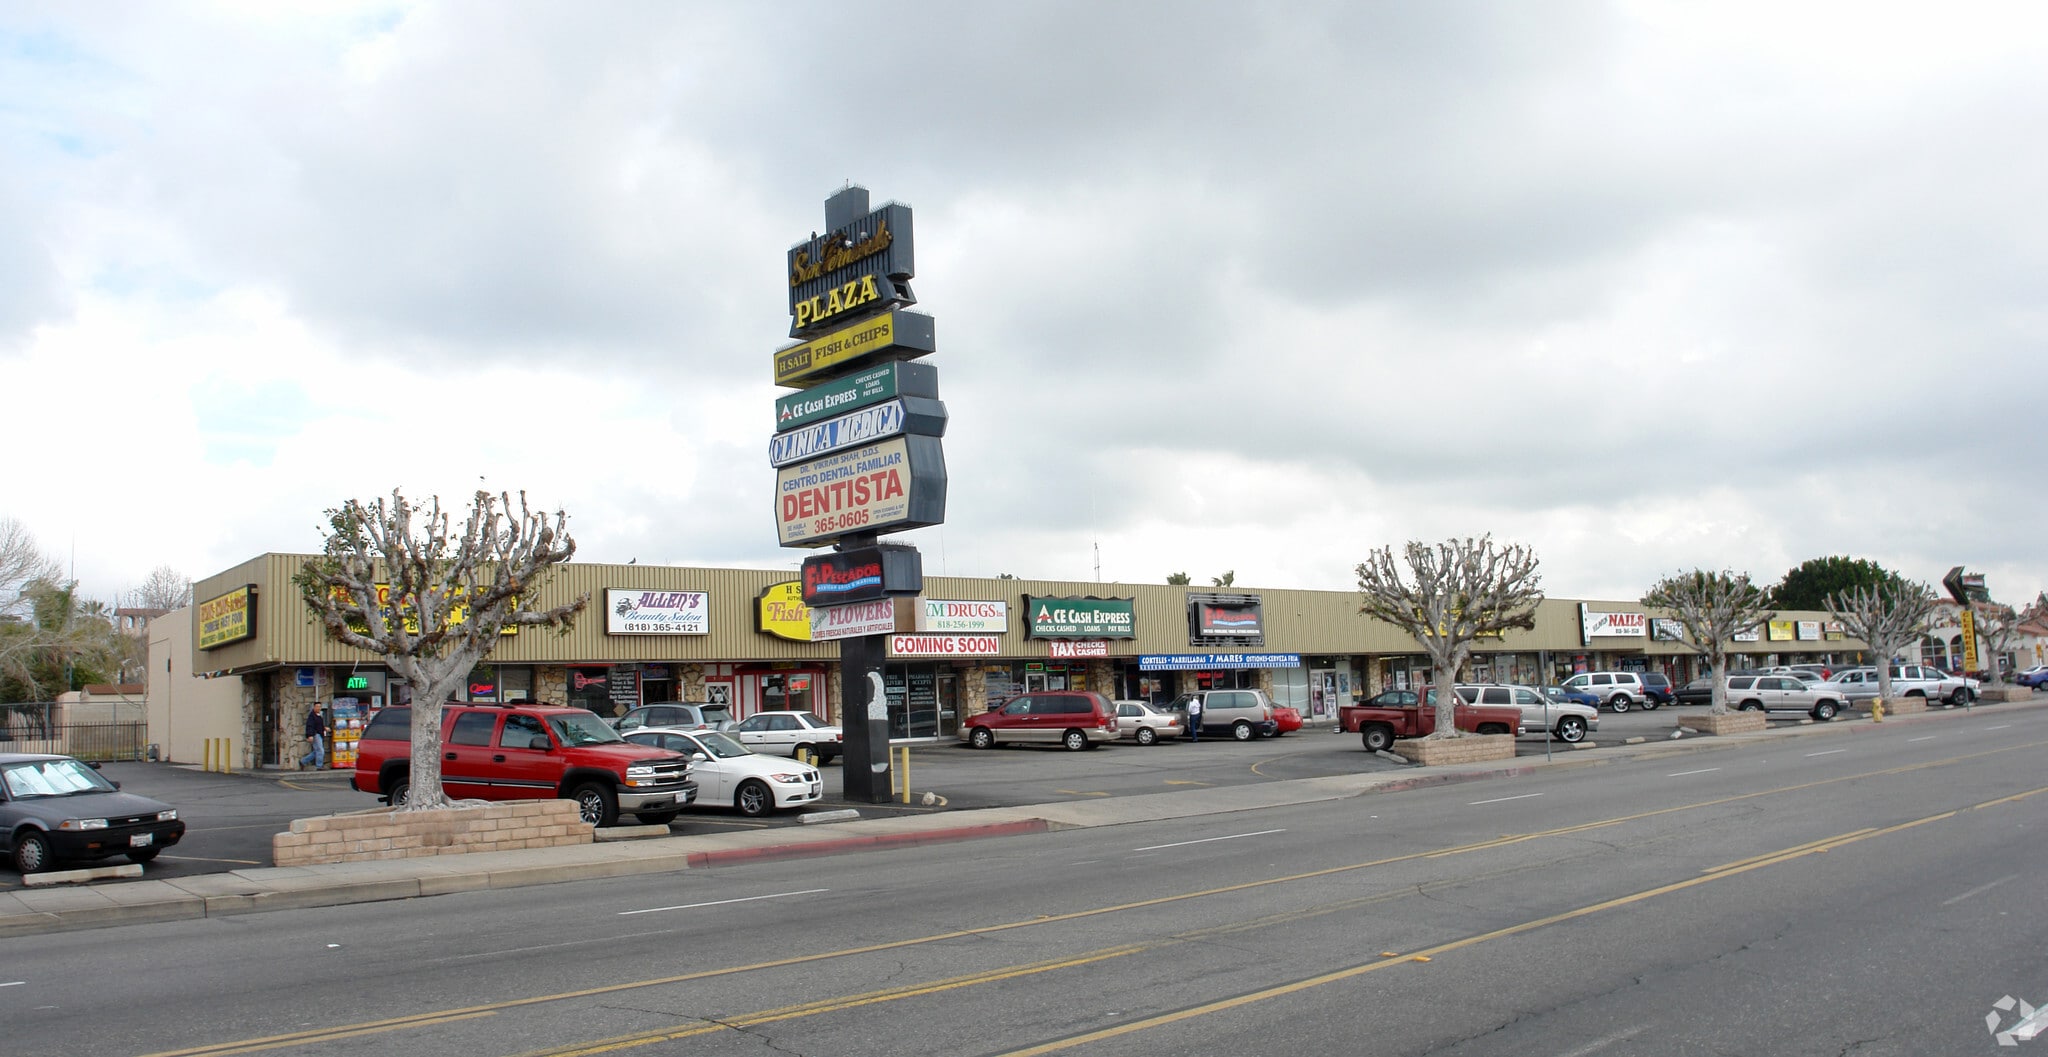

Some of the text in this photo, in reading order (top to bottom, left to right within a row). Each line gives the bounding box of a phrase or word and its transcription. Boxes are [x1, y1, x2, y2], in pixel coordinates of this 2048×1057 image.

[795, 274, 879, 328] PLAZA
[815, 341, 842, 360] FISH
[844, 339, 852, 349] &
[852, 323, 890, 347] CHIPS
[855, 368, 890, 385] CHECKS CASHED
[865, 380, 880, 389] LOANS
[804, 401, 823, 415] CASH
[825, 389, 857, 408] EXPRESS
[774, 403, 902, 463] CLINICA MEDICA
[783, 452, 902, 492] CENTRO DENTAL FAMILIAR
[813, 457, 839, 471] VIKRAM
[783, 468, 904, 522] DENTISTA
[814, 508, 869, 534] 365-0605
[820, 563, 881, 584] PESCADOR
[624, 611, 702, 622] Beauty Salon
[767, 601, 805, 622] Fish
[829, 600, 893, 626] FLOWERS
[947, 603, 996, 617] DRUGS
[1068, 609, 1091, 624] CASH
[1094, 609, 1130, 624] EXPRESS
[624, 623, 699, 632] (818) 365-4121
[937, 621, 985, 629] 818-256-1999
[1608, 614, 1644, 627] NAILS
[826, 628, 841, 637] FRESCAS
[841, 626, 863, 635] NATURALES
[867, 622, 893, 632] ARTIFICIALES
[894, 637, 998, 653] COMING SOON
[1051, 641, 1076, 657] TAX
[1076, 648, 1107, 656] CASHED
[1209, 654, 1214, 663] 7
[1216, 654, 1243, 663] MARES
[347, 677, 368, 689] ATM
